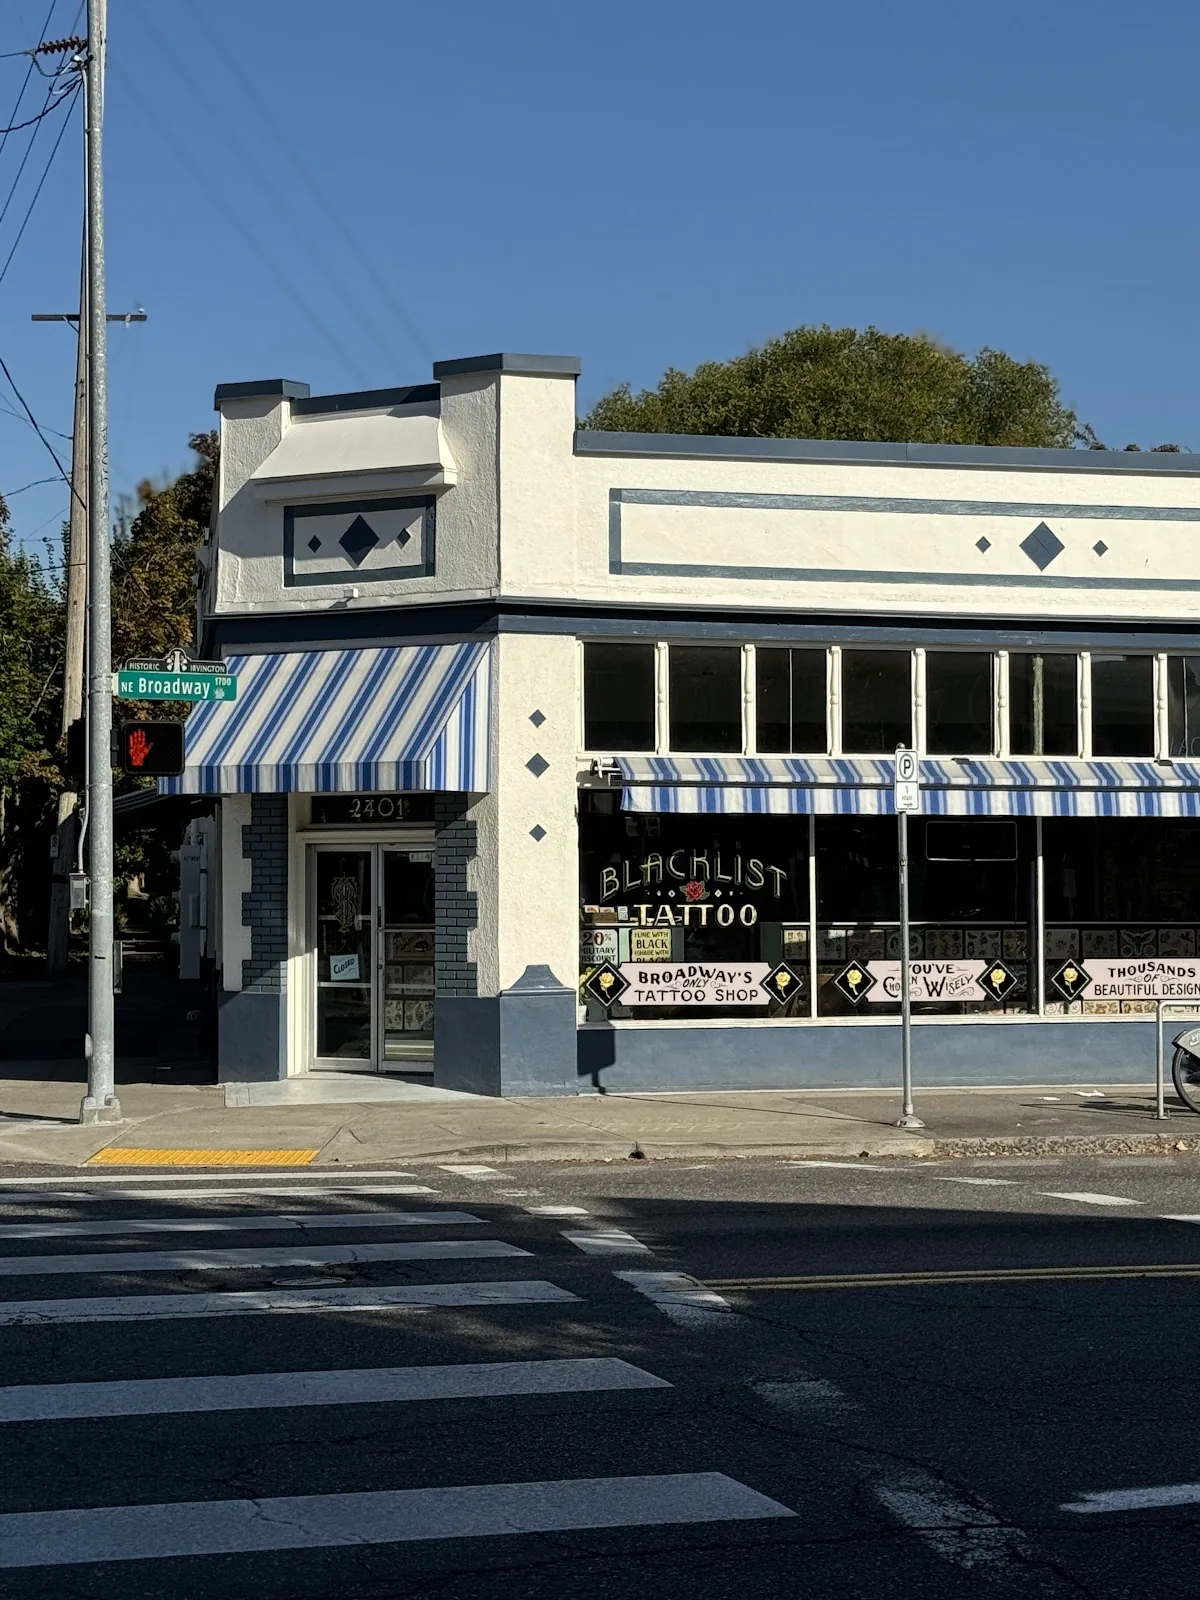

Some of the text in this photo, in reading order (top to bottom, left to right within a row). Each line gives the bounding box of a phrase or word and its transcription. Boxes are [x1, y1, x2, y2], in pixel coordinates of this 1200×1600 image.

[129, 662, 225, 673] HISTORIC IRVINGTON
[121, 677, 211, 699] NE Broadway
[214, 677, 232, 686] 1700
[903, 759, 911, 775] P
[904, 785, 909, 795] 1
[350, 797, 404, 819] 2401
[600, 849, 788, 902] BLACKLIST
[633, 903, 758, 927] TATTOO
[582, 931, 612, 946] 20%
[636, 938, 668, 949] BLACK
[638, 965, 752, 985] BROADWAY'S
[908, 963, 955, 975] OU'VE
[1107, 961, 1196, 978] THOUSANDS
[682, 978, 709, 988] ONLY
[1143, 973, 1160, 983] OF
[882, 975, 918, 998] CHON
[1094, 983, 1200, 996] BEAUTIFUL DESIGN
[634, 989, 759, 1002] TATTOO SHOP
